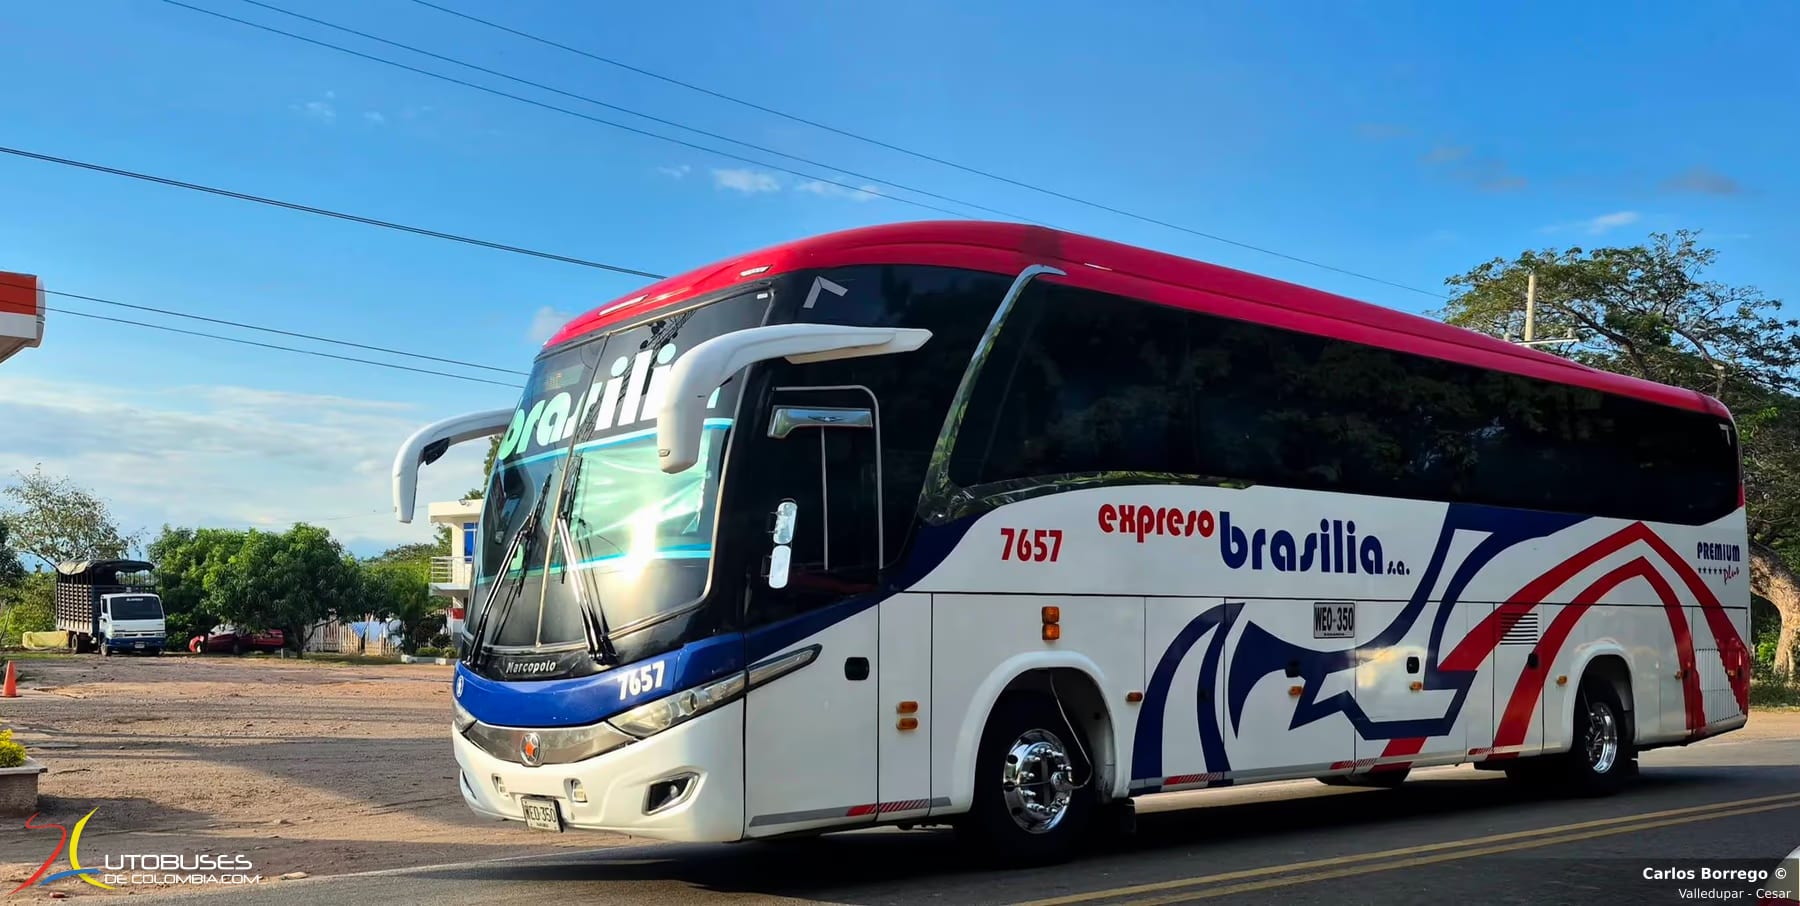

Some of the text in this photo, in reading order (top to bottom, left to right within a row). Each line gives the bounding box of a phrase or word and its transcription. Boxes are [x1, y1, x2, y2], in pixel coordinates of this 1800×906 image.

[498, 343, 720, 460] brasili
[1000, 528, 1063, 563] 7657
[1098, 503, 1215, 543] expreso
[1219, 511, 1383, 575] brasilia
[1697, 541, 1740, 562] PREMIUM
[505, 660, 557, 673] Marcopolo
[617, 660, 665, 700] 7657
